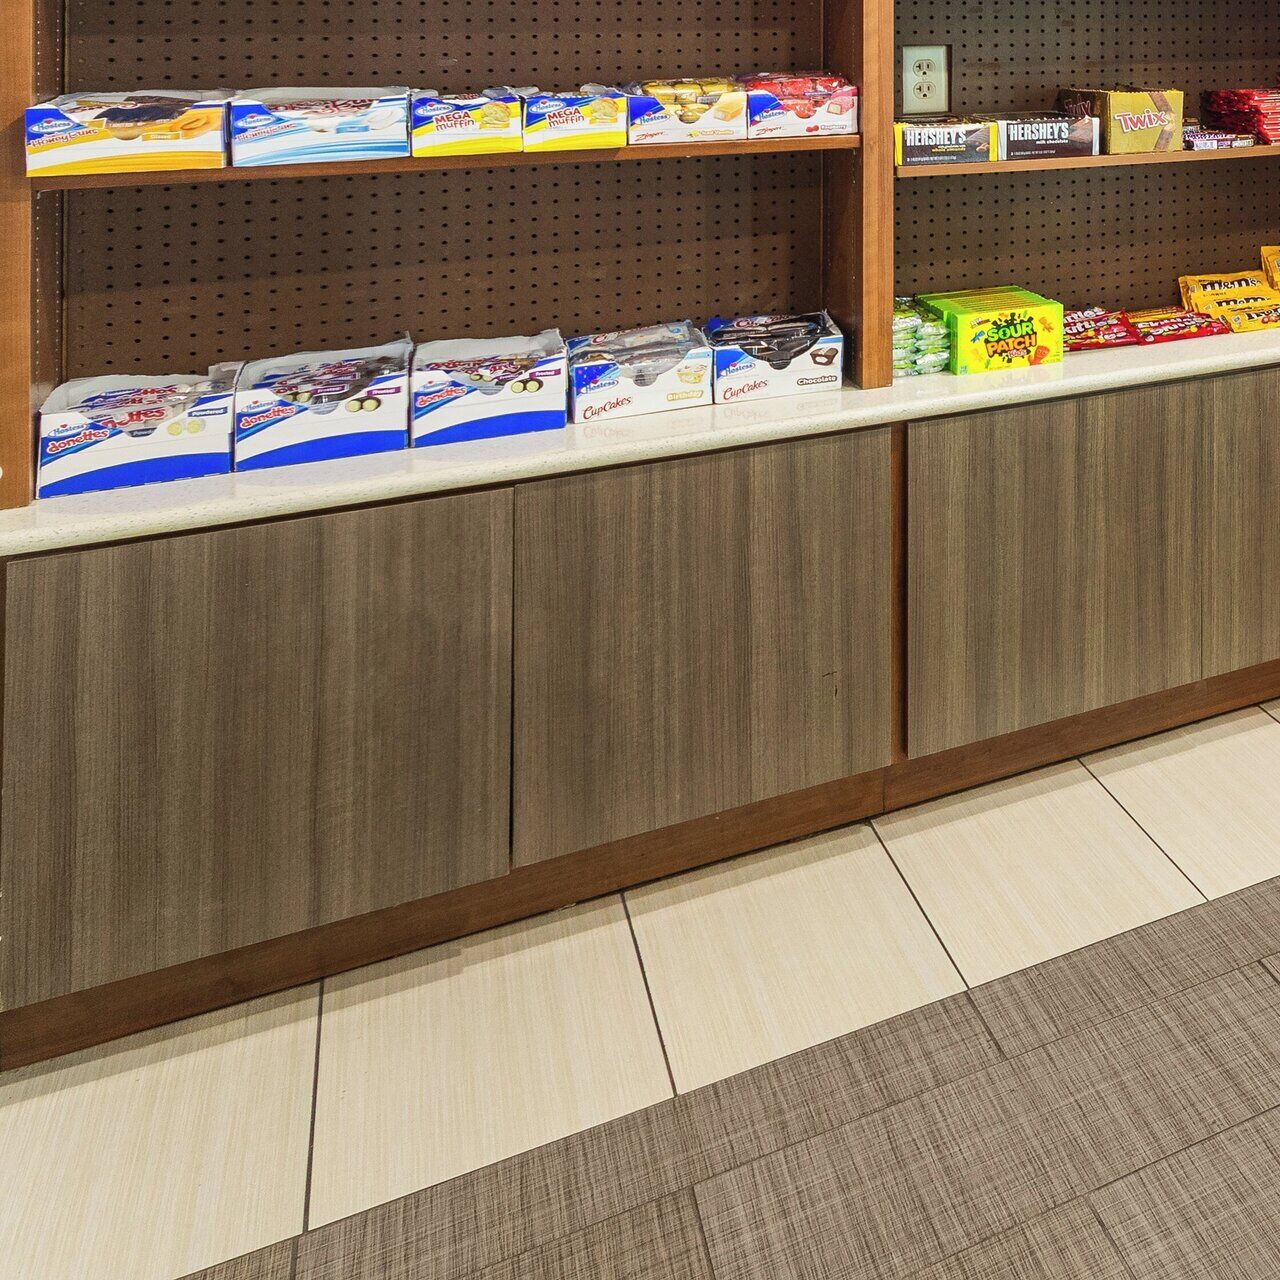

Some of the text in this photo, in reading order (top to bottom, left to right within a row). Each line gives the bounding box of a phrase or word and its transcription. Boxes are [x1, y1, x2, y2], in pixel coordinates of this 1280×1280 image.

[433, 111, 470, 124] MEGA
[436, 118, 476, 132] muffin
[545, 108, 581, 122] MEGA
[547, 115, 585, 129] muffin
[1115, 108, 1169, 133] Twix
[906, 128, 967, 147] HERSHEY'S
[1009, 122, 1070, 141] HERSHEY'S
[986, 321, 1034, 342] SOUR
[985, 333, 1038, 357] PATCH
[722, 379, 769, 401] CupCakes
[796, 374, 838, 387] Chocolate
[240, 406, 296, 429] donettes
[583, 395, 633, 420] CupCakes
[47, 429, 109, 454] donettes
